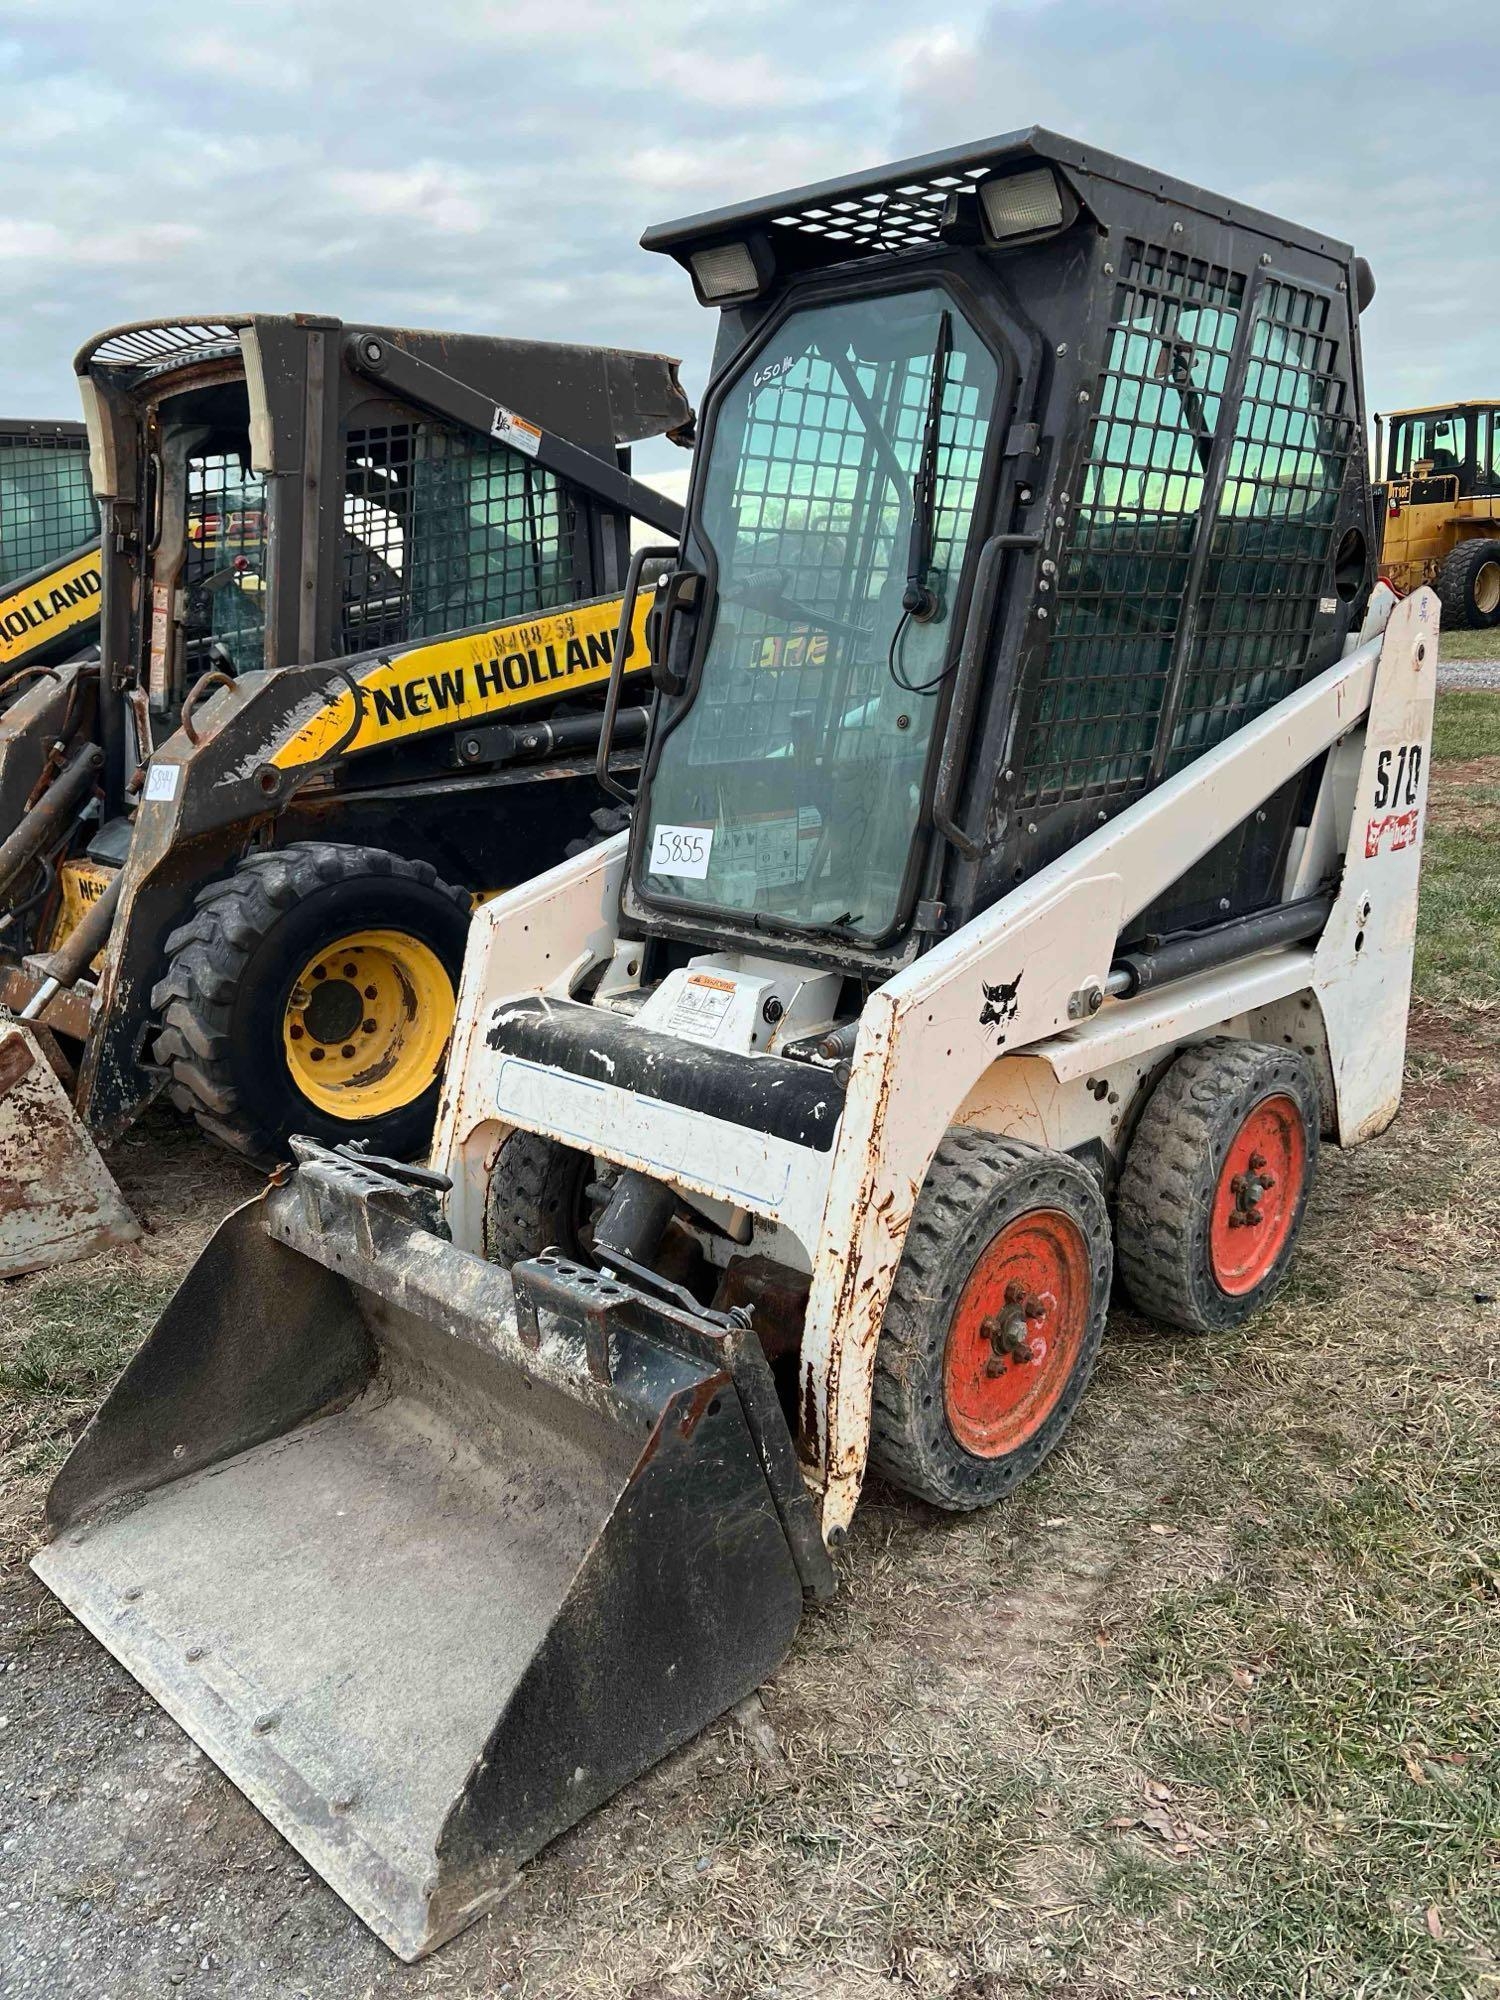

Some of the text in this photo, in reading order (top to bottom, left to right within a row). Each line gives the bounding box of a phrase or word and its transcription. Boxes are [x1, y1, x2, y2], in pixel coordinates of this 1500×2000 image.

[373, 628, 634, 726] NEW HOLLAND
[656, 831, 704, 865] 5855
